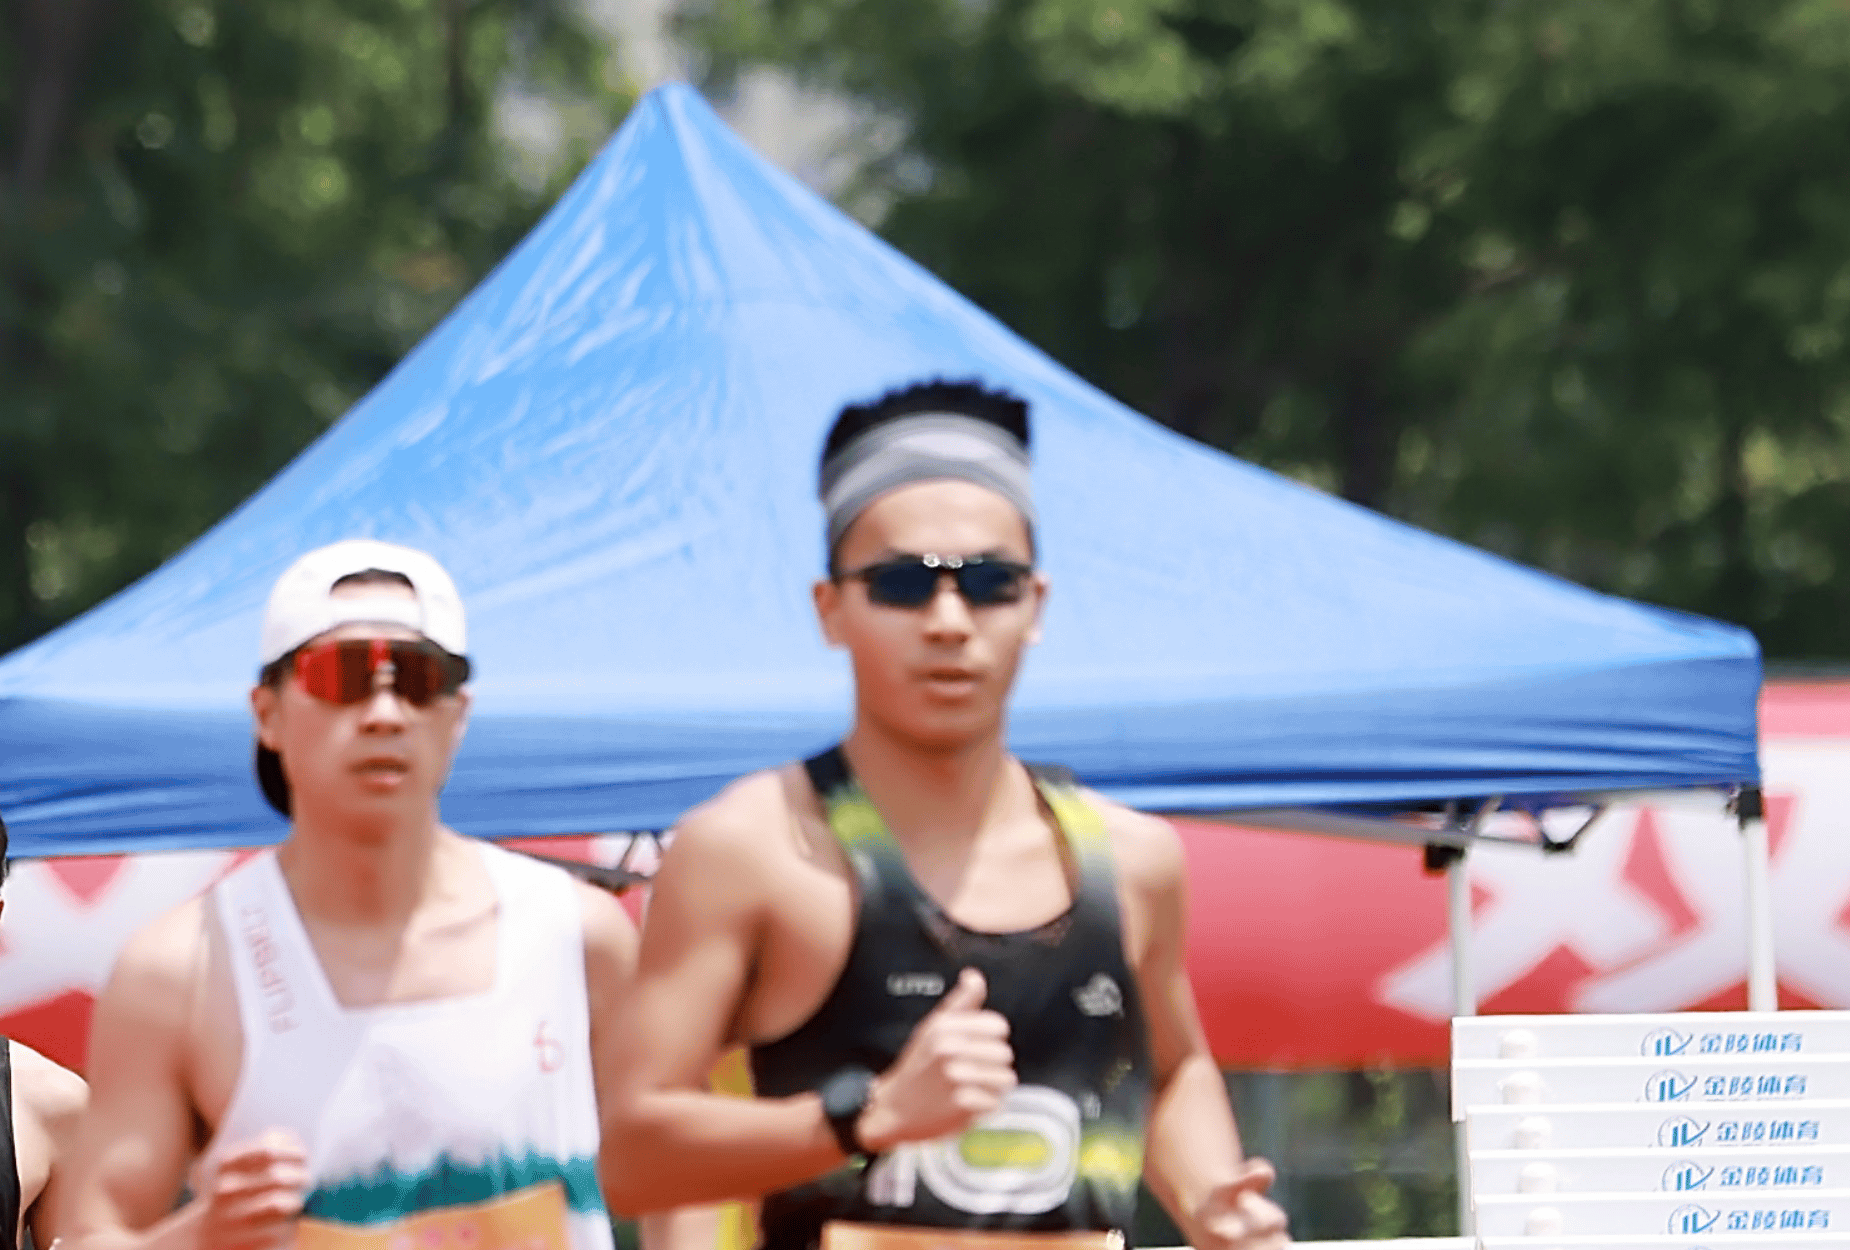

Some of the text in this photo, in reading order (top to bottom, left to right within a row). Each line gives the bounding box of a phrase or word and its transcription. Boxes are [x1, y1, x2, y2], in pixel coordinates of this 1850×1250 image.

[1700, 1032, 1802, 1053] 金陵体育
[1705, 1074, 1807, 1096] 金陵体育
[1717, 1120, 1819, 1142] 金陵体育
[1721, 1165, 1823, 1187] 金陵体育
[1727, 1209, 1830, 1231] 金陵体育
